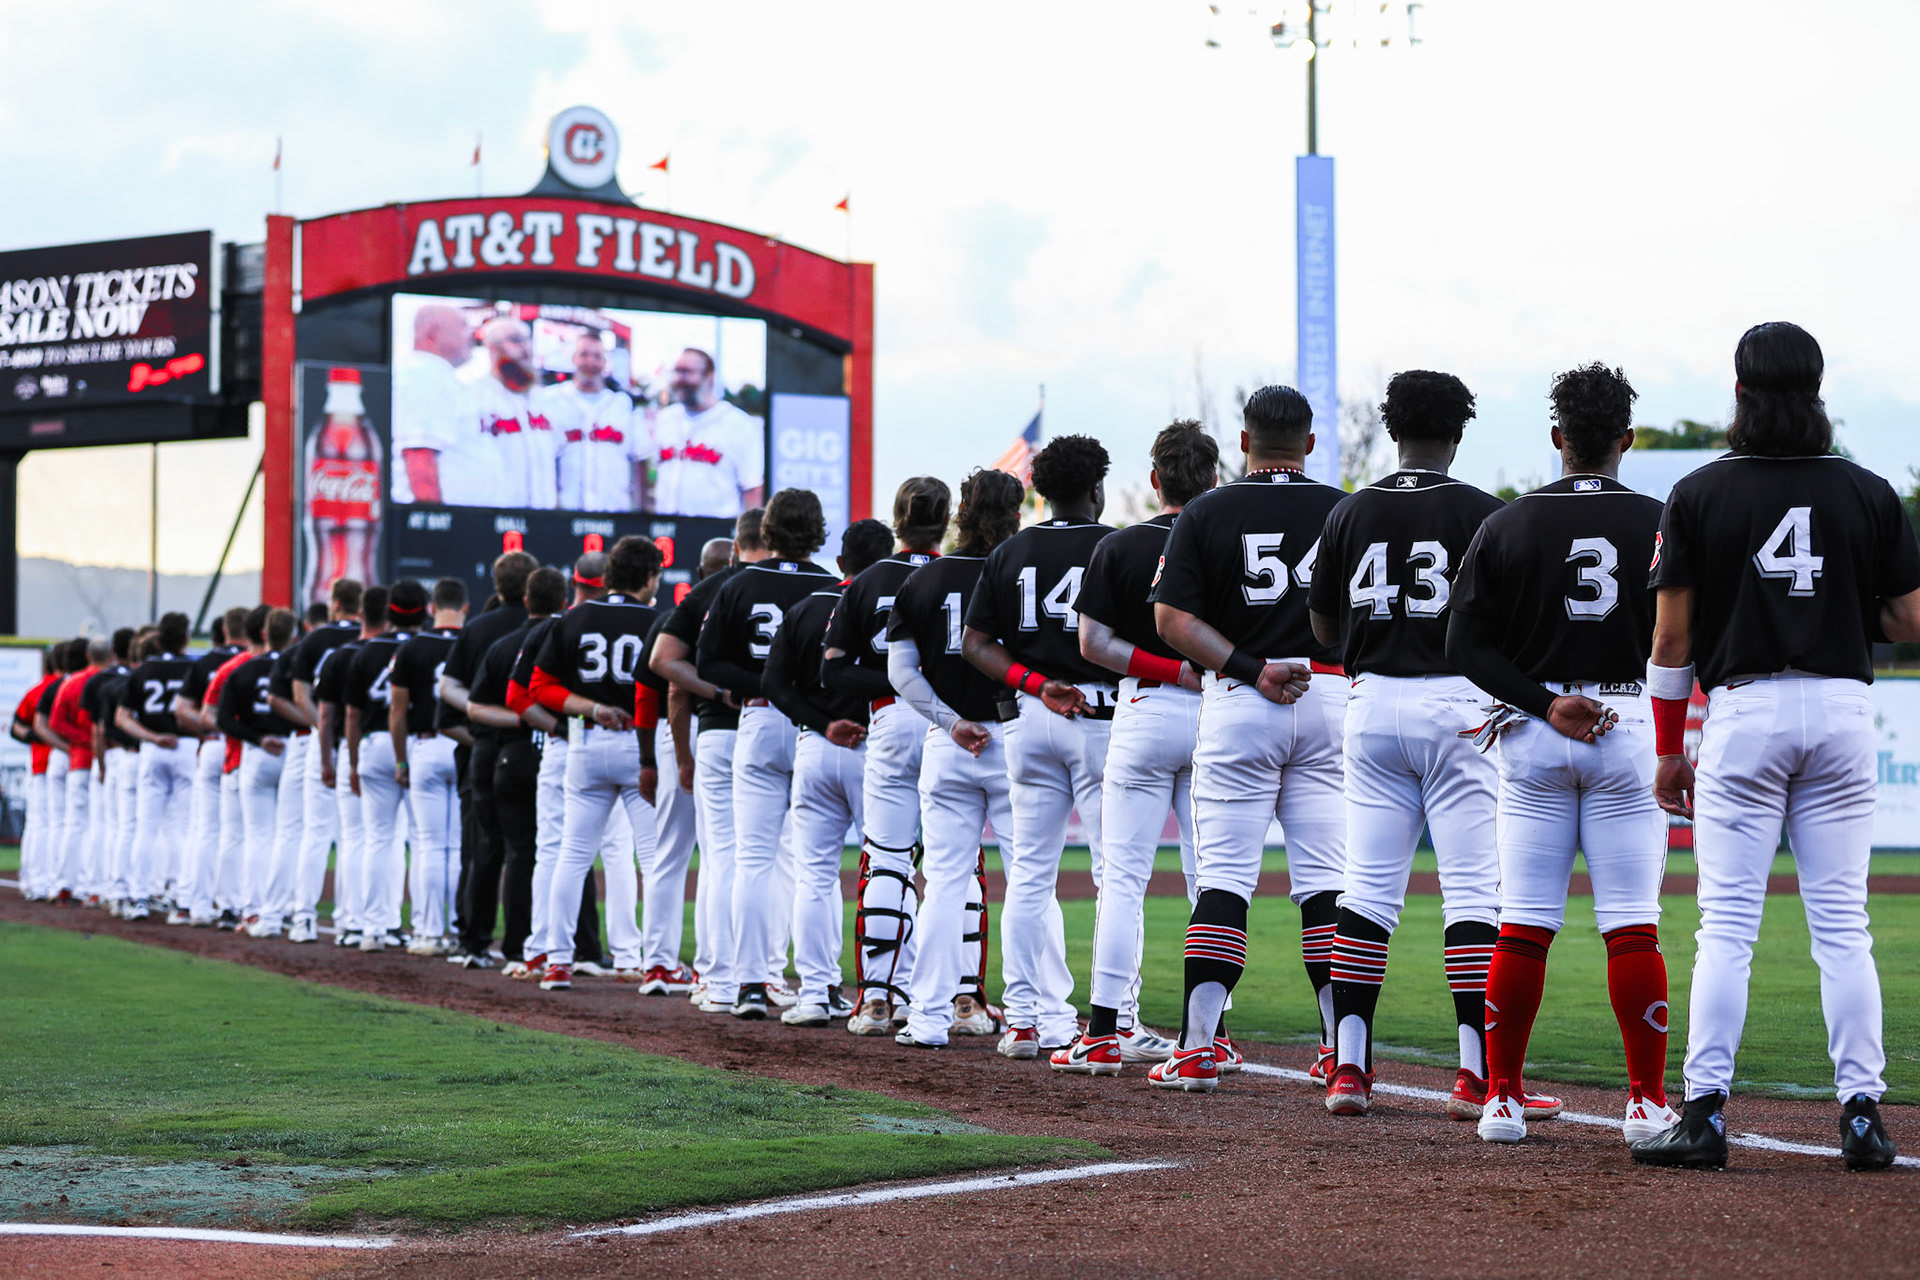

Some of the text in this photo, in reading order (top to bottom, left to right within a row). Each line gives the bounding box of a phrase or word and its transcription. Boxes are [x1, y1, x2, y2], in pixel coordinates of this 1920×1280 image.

[74, 262, 198, 304] TICKETS
[407, 211, 756, 299] AT&T FIELD
[1304, 204, 1328, 317] INTERNET
[0, 301, 149, 346] SALE NOW
[778, 428, 842, 462] GIG
[1349, 540, 1449, 621] 43
[1564, 537, 1619, 622] 3
[1752, 506, 1824, 597] 4
[1016, 566, 1086, 632] 14
[578, 632, 644, 684] 30
[747, 603, 784, 659] 3
[143, 679, 185, 713] 27
